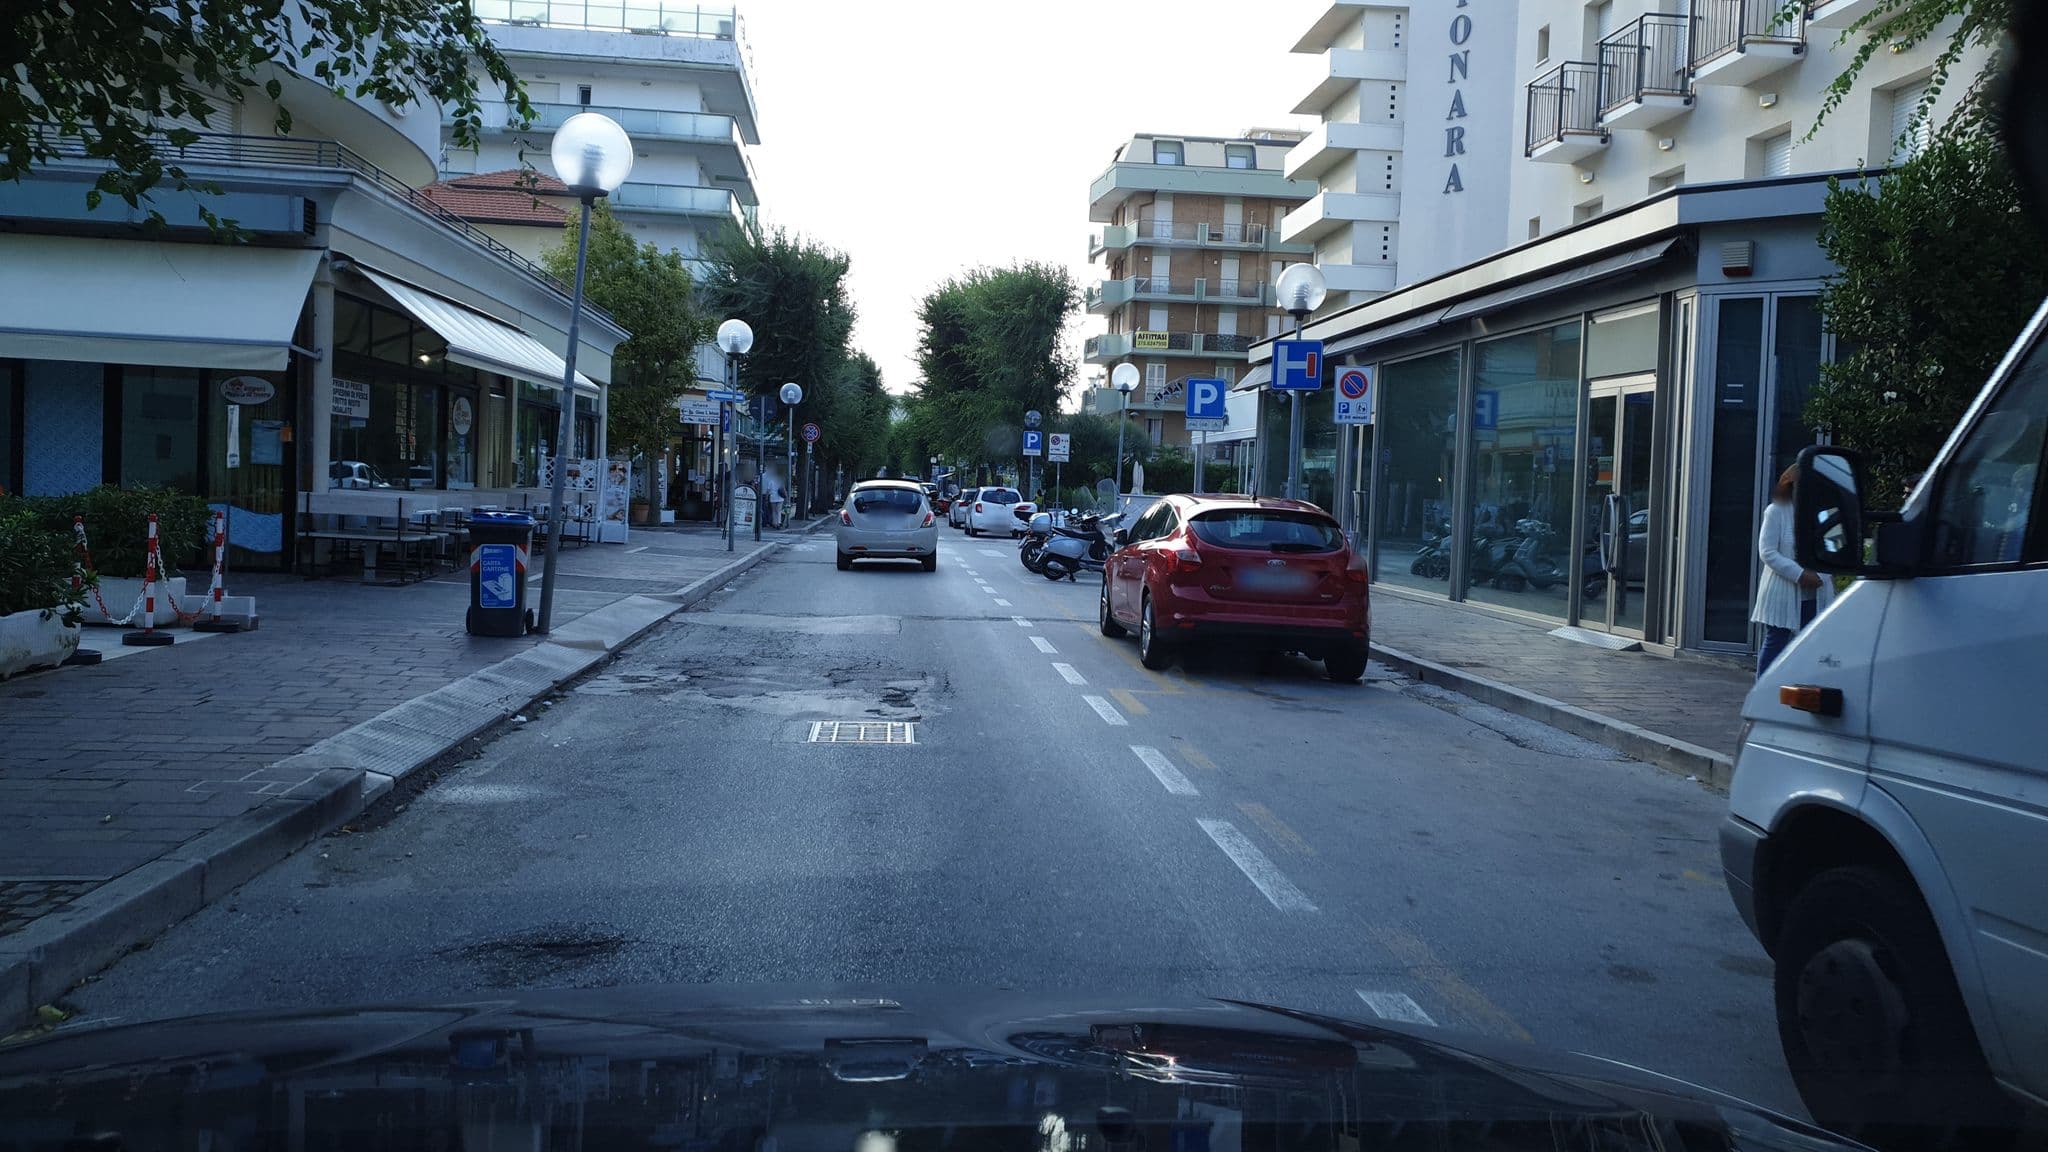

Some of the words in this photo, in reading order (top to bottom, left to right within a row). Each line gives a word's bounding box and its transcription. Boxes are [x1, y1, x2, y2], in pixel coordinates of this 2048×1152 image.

[1442, 0, 1472, 194] ONARA
[1194, 383, 1218, 414] P
[1341, 403, 1348, 413] P
[1027, 433, 1039, 448] P
